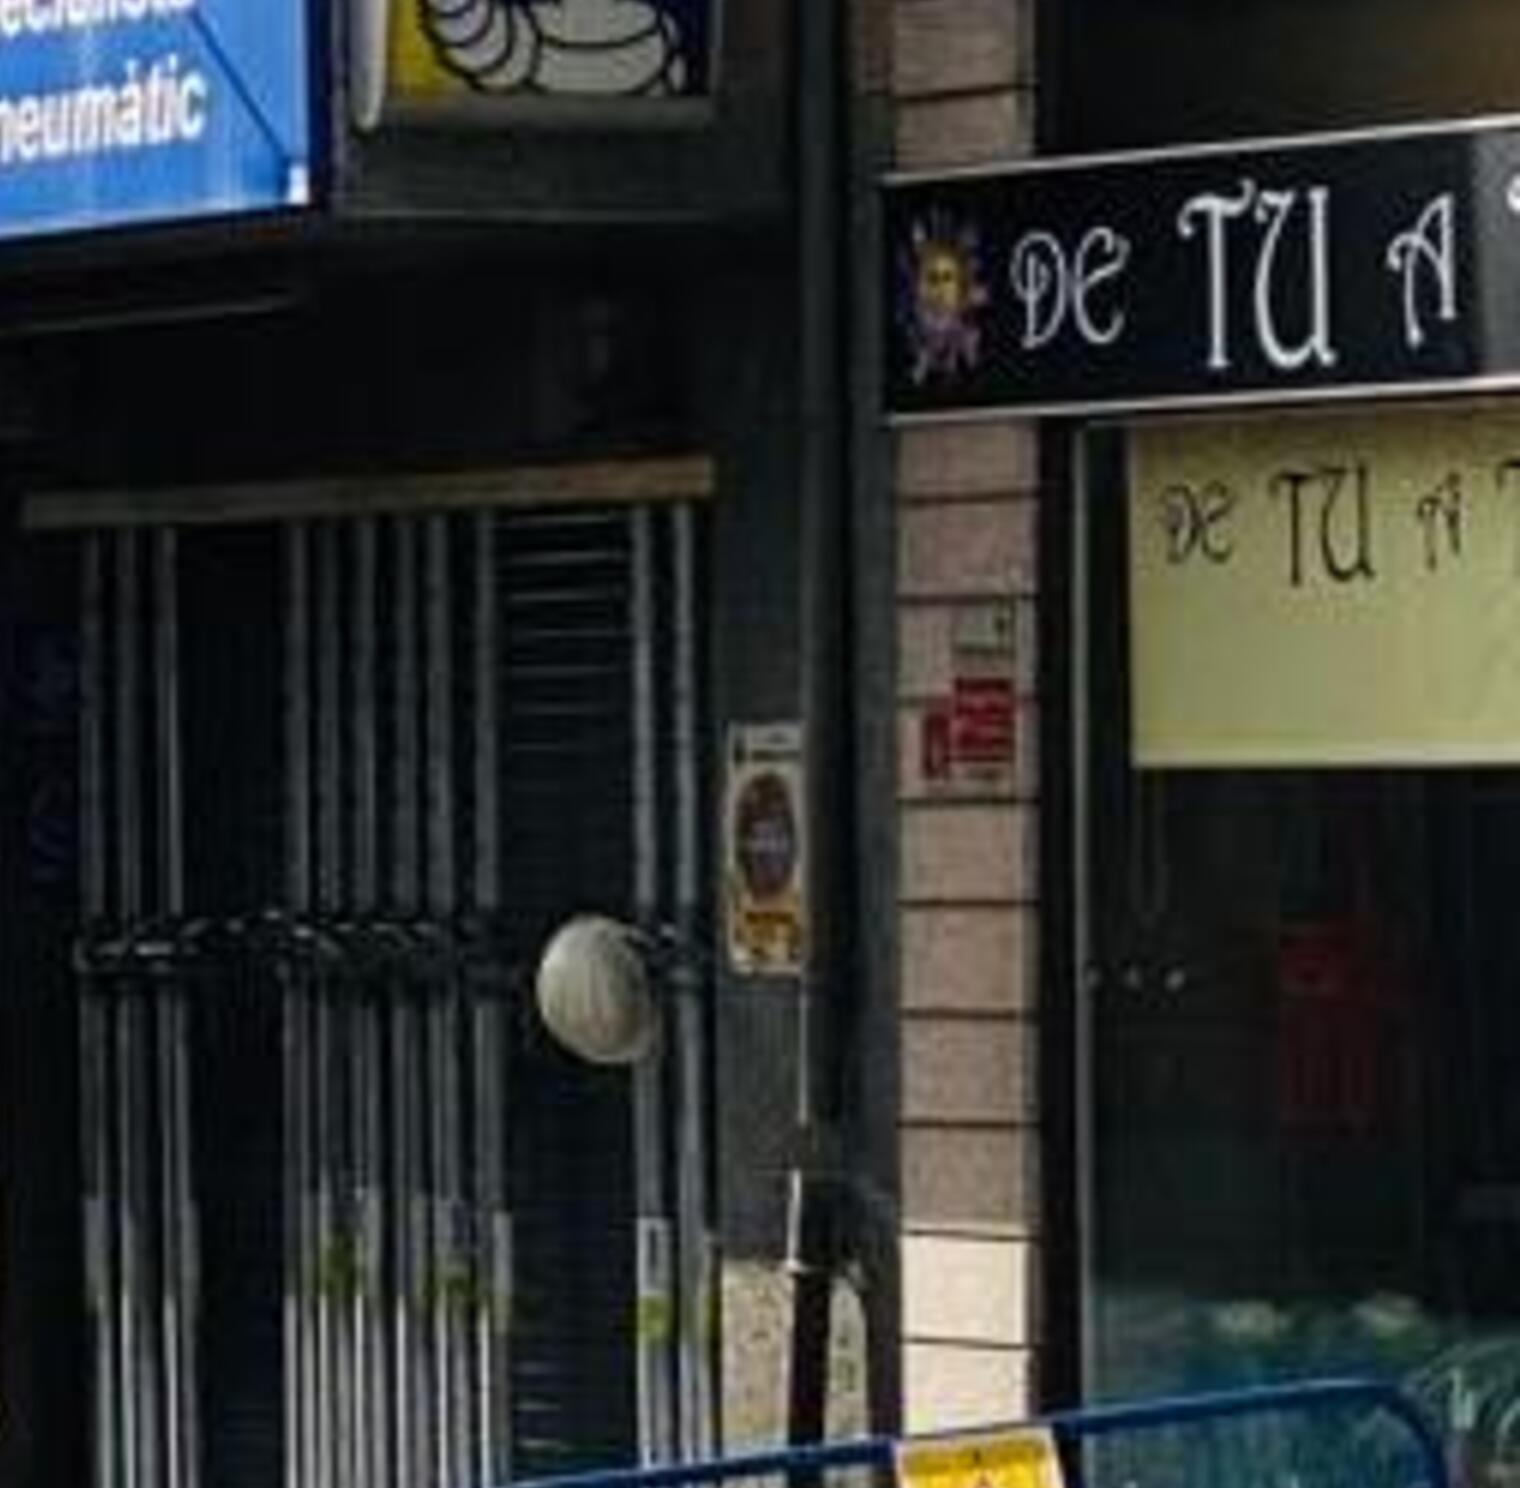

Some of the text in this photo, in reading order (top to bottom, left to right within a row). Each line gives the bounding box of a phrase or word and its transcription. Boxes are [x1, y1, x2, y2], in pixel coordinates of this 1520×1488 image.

[1010, 178, 1458, 370] DE TU A
[1160, 480, 1236, 566] DE
[1268, 459, 1376, 588] TU
[1416, 470, 1464, 570] A
